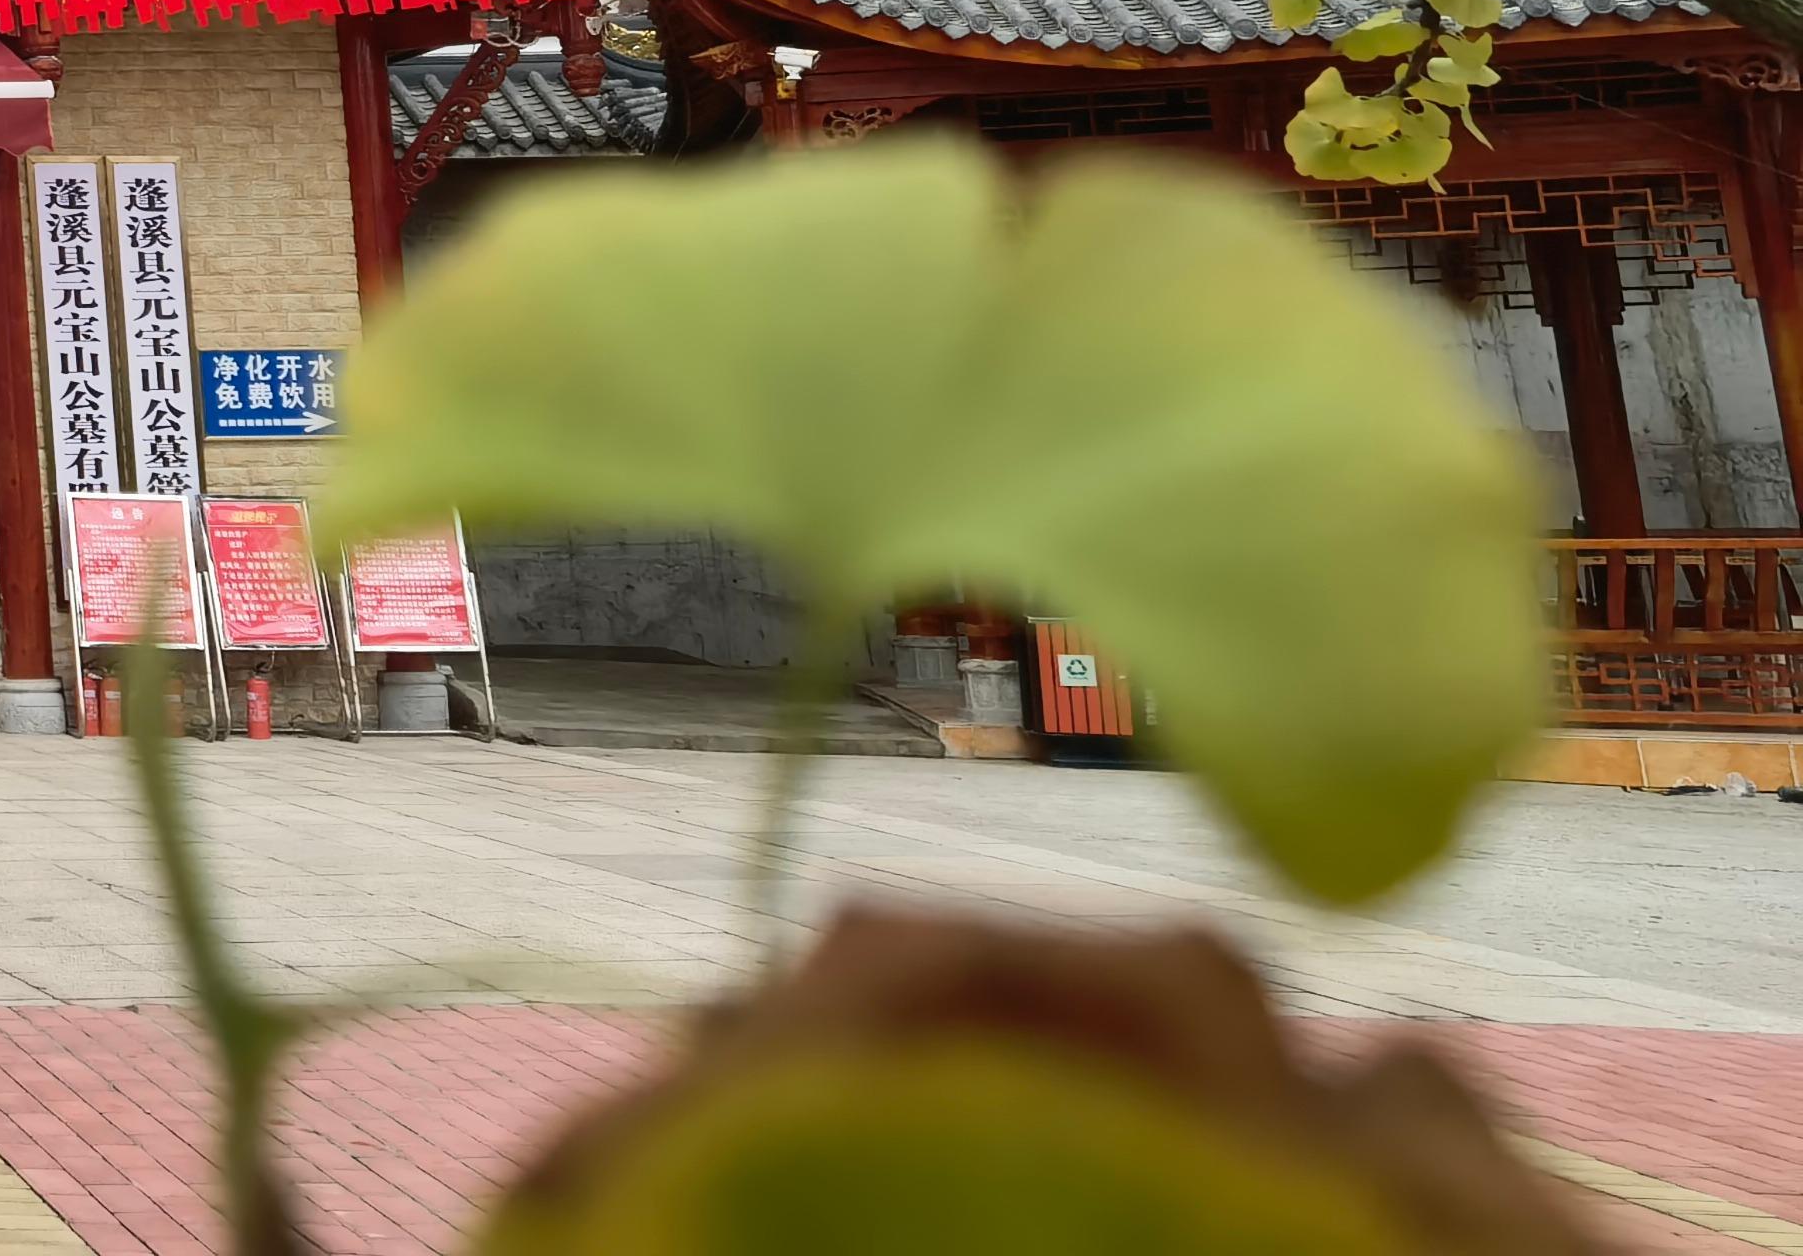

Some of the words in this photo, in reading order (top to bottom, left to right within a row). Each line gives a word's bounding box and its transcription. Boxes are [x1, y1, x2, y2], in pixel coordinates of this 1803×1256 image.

[212, 354, 336, 381] 净化开水
[215, 382, 335, 410] 免费饮用
